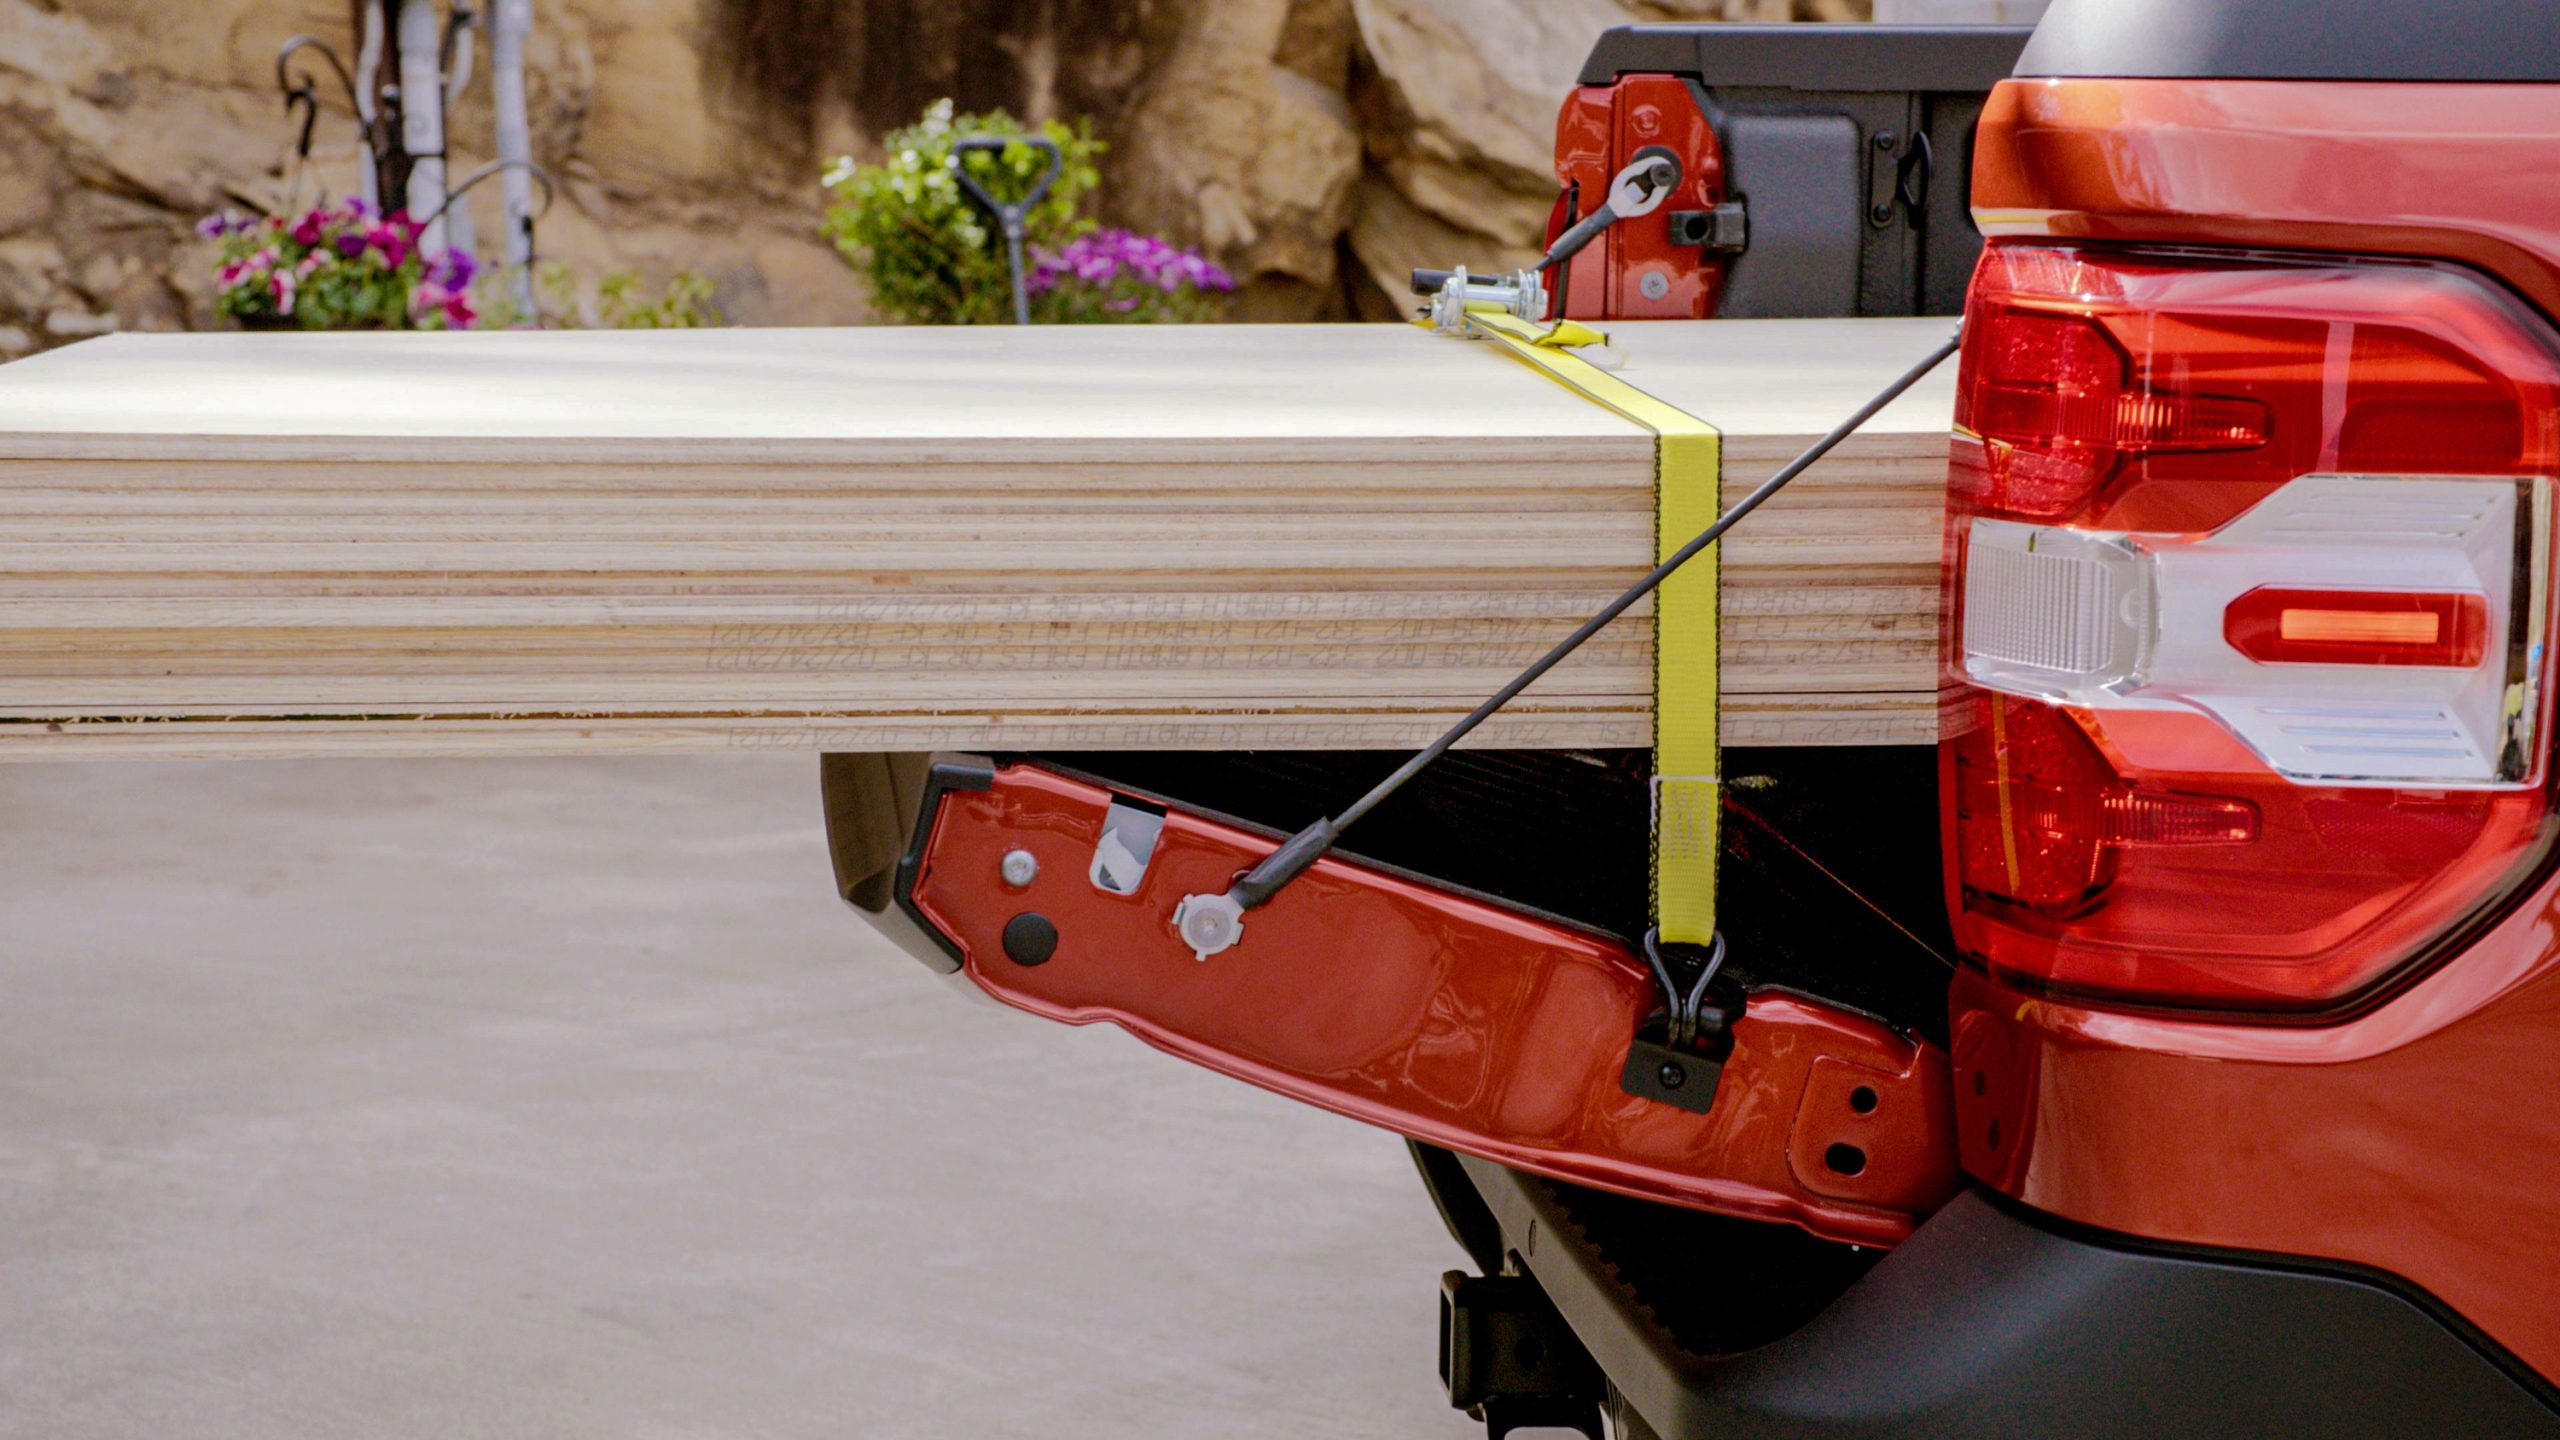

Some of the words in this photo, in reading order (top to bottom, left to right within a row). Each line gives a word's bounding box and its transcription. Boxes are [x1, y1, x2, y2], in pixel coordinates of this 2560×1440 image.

[1101, 596, 1187, 619] FALLS
[942, 622, 979, 645] OR
[997, 622, 1090, 644] FALLS
[1106, 621, 1233, 643] KLAMATH
[706, 647, 877, 670] 02/24/2021
[900, 646, 932, 670] KF
[948, 646, 983, 669] OR
[999, 646, 1088, 669] FALLS
[1104, 645, 1227, 669] KLAMATH
[1246, 645, 1362, 668] 332-021
[728, 727, 899, 748] 02/24/2021
[919, 726, 951, 746] KF
[969, 725, 1003, 745] OR
[1020, 725, 1107, 745] FALLS
[1122, 724, 1244, 745] KLAMATH
[1587, 721, 1638, 744] FSC
[1751, 720, 1783, 742] C3
